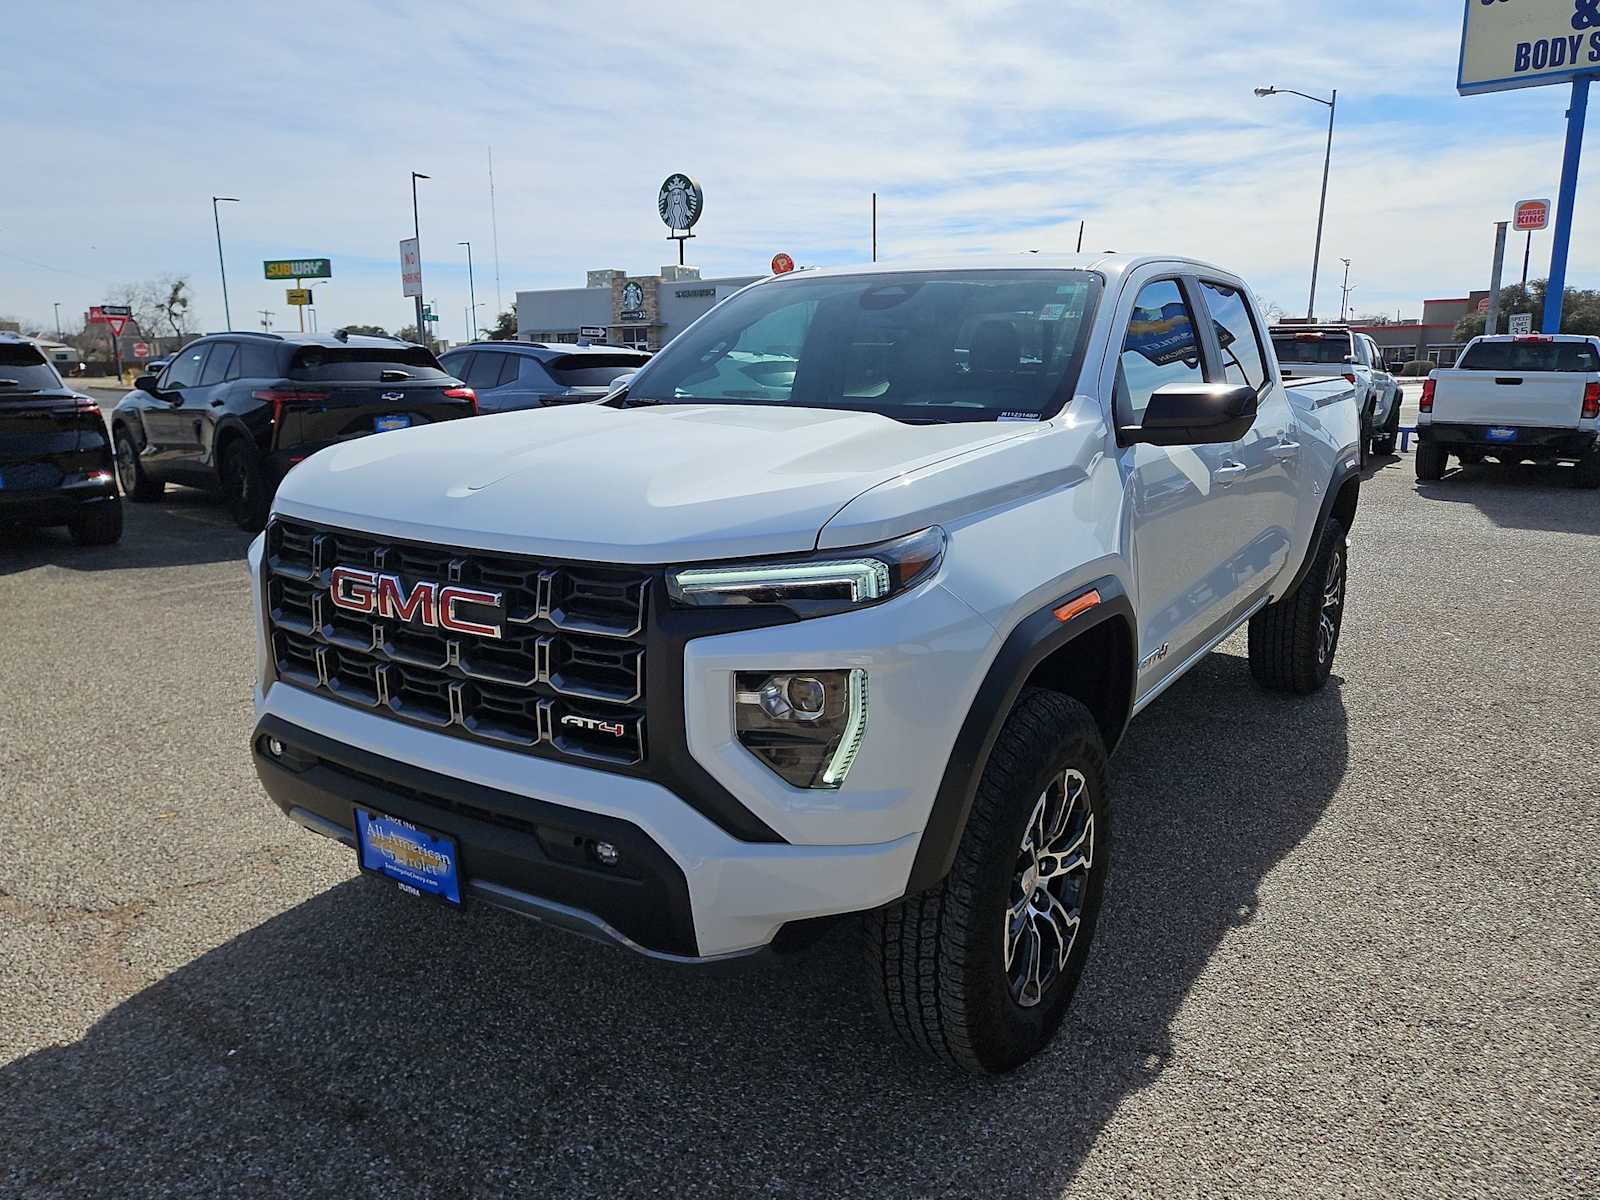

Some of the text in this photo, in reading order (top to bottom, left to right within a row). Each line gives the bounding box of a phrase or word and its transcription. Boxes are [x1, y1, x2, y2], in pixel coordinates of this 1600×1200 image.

[1514, 34, 1584, 72] BODY
[1517, 215, 1545, 224] KING
[1518, 208, 1546, 216] BURGER
[266, 261, 321, 278] SUBWAY
[1512, 327, 1529, 335] 35
[330, 566, 502, 639] GMC
[561, 715, 624, 737] AT4
[368, 822, 450, 865] All American
